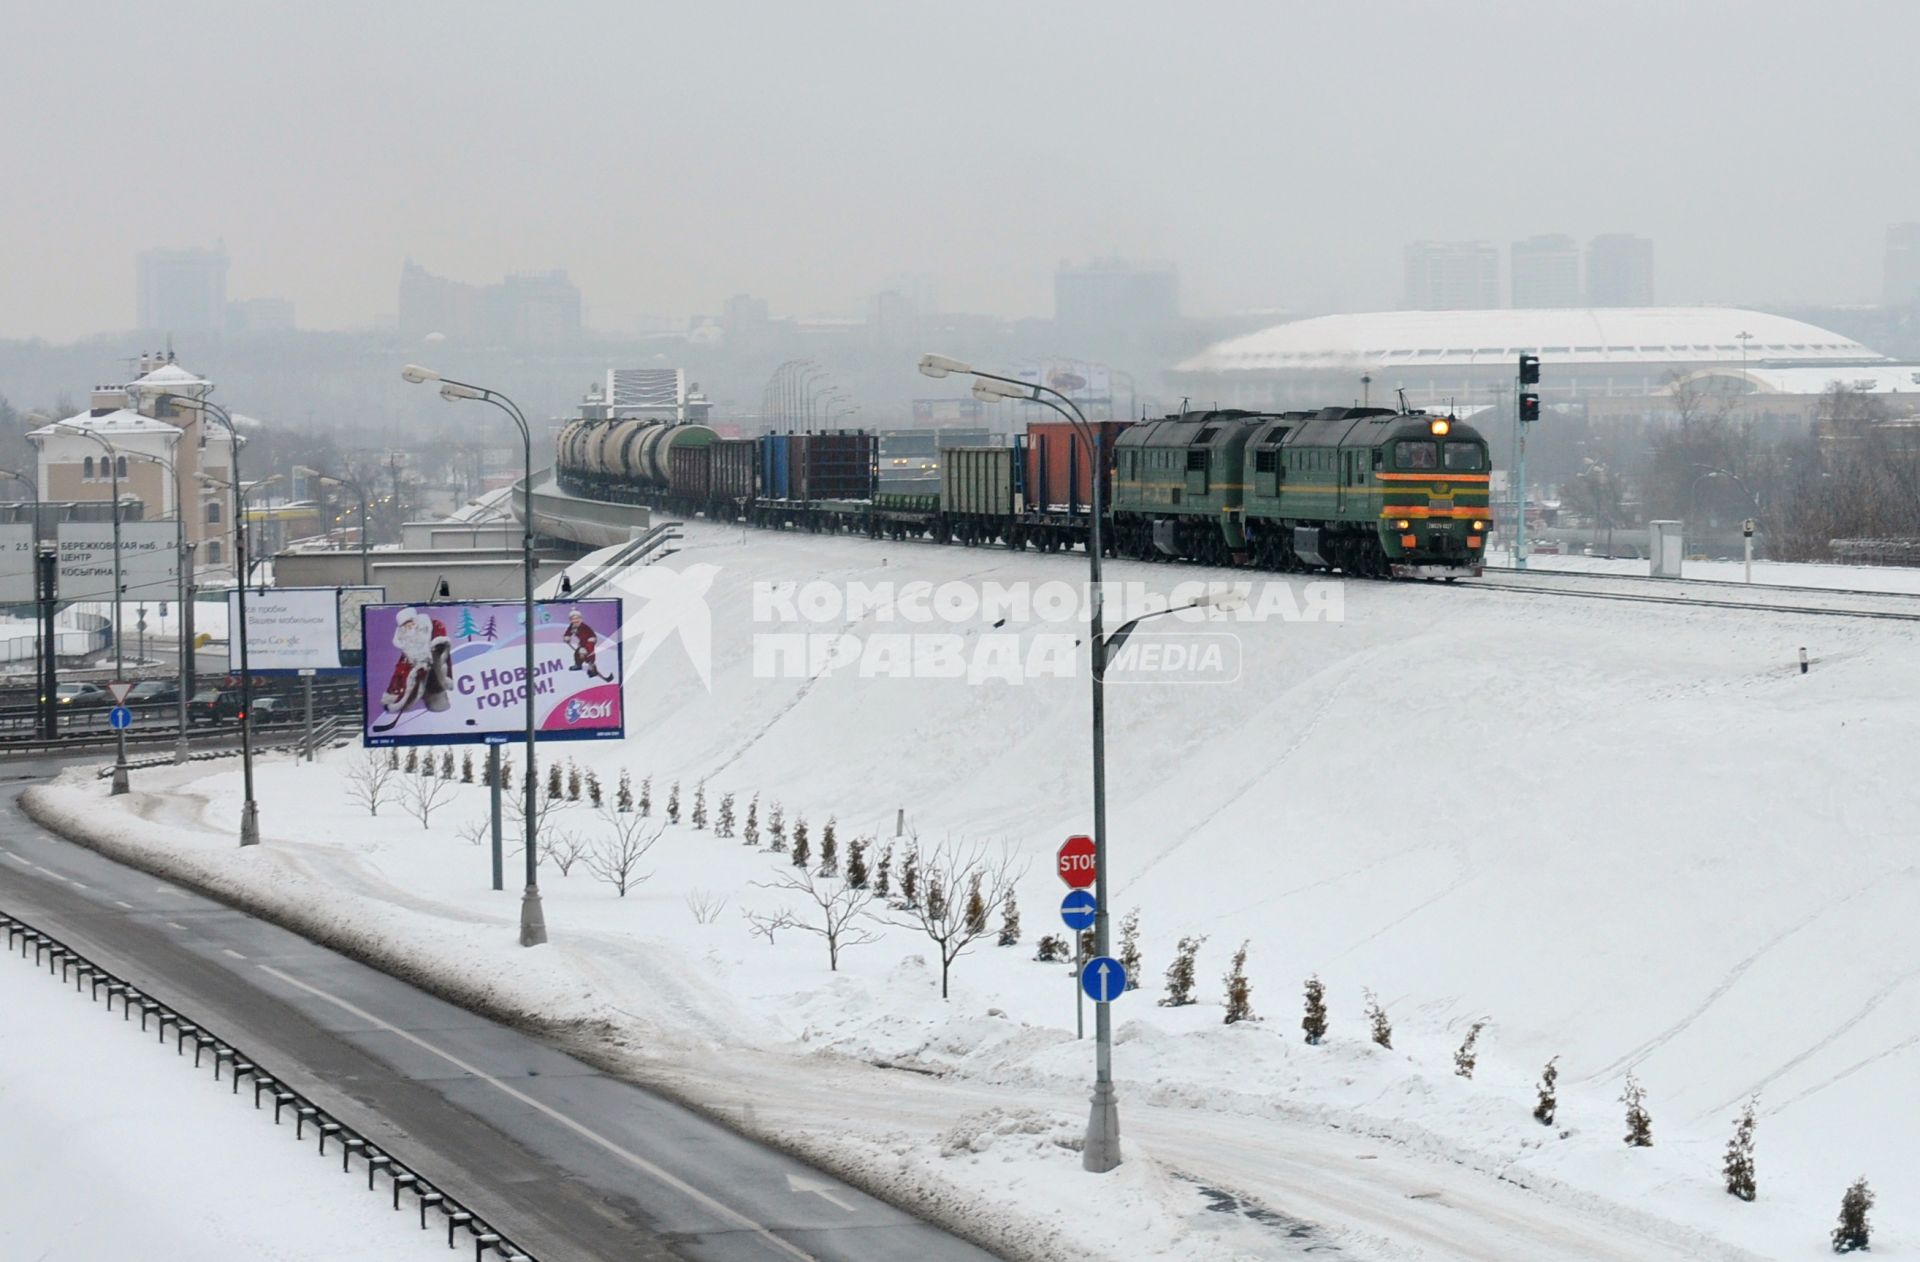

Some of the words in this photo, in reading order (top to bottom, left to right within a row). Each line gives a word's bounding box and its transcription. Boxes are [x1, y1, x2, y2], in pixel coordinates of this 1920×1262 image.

[61, 553, 92, 562] ЦЕНТР
[61, 568, 114, 576] КОСЫГИНА
[457, 674, 476, 695] С
[480, 658, 564, 690] Новым
[476, 677, 555, 710] годом!
